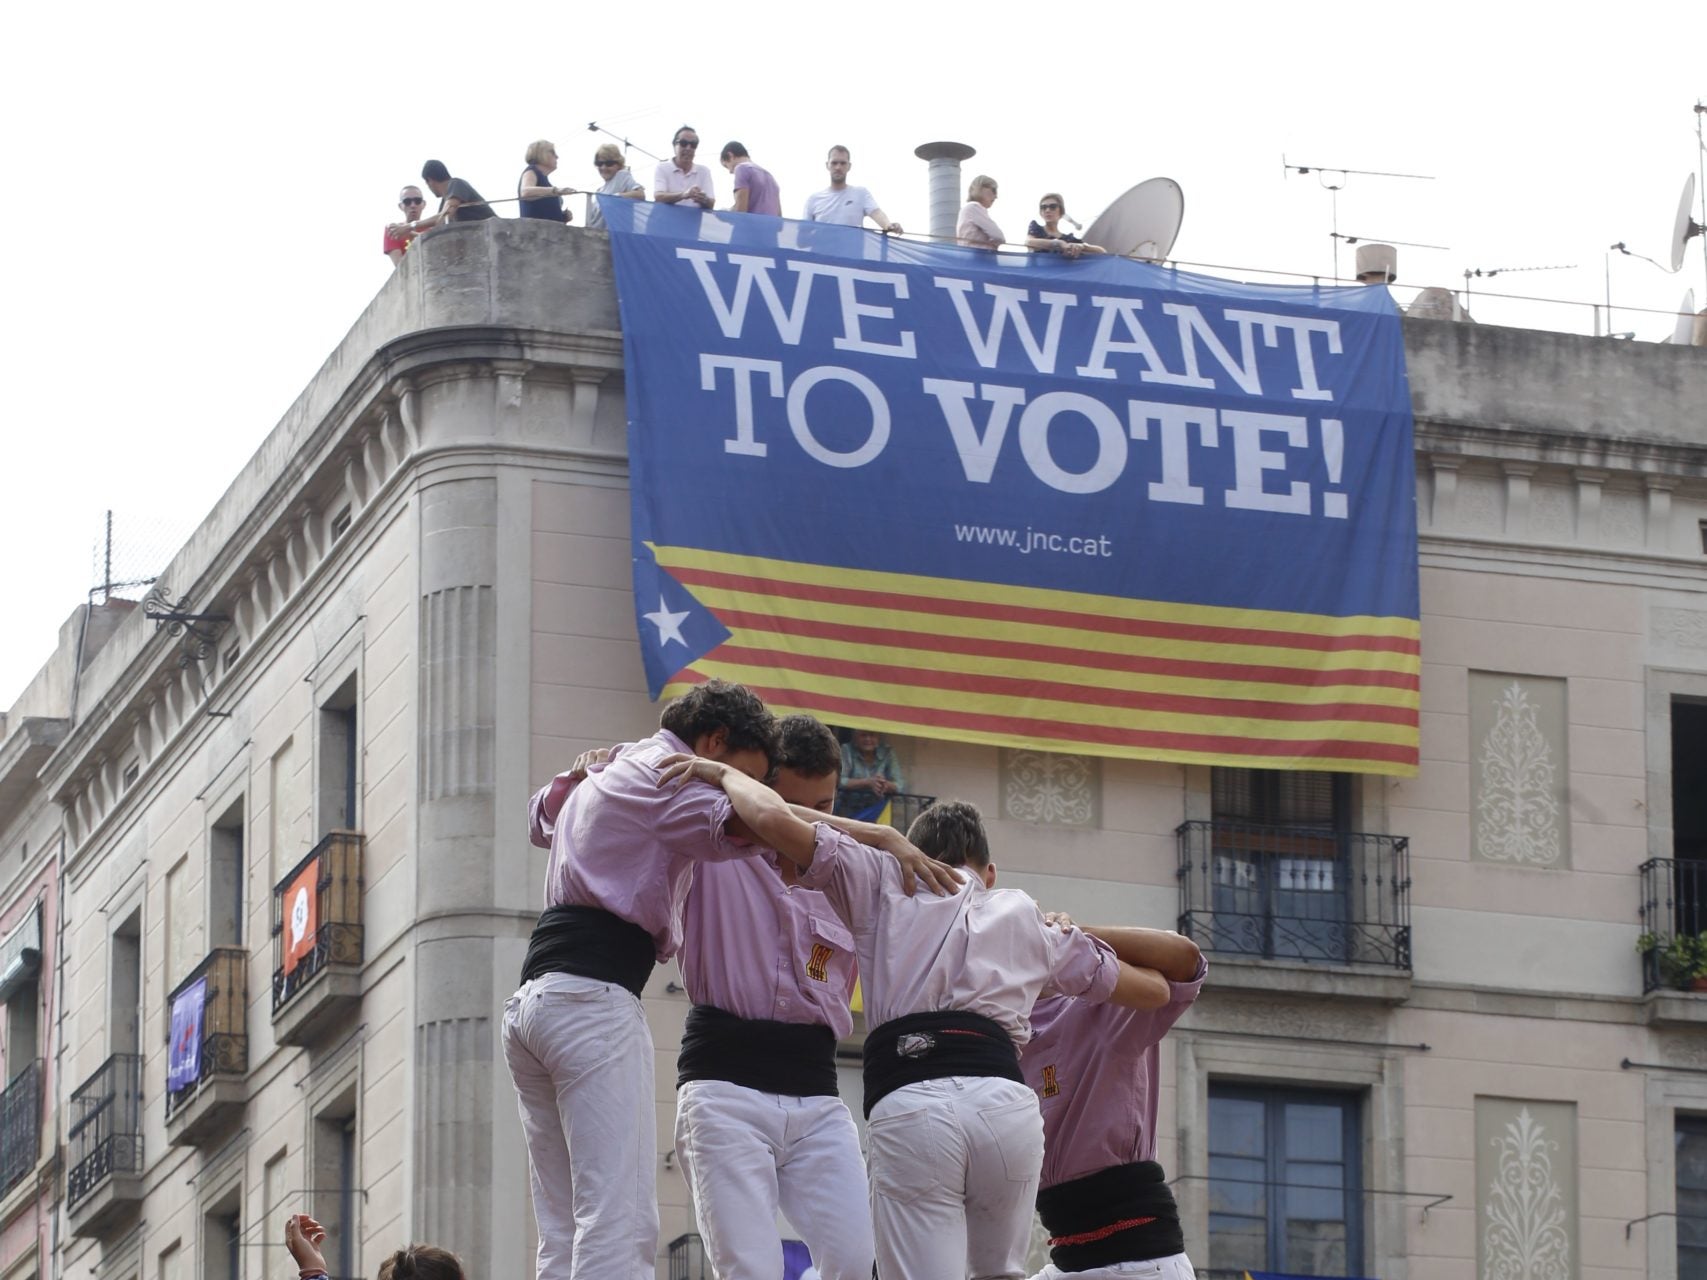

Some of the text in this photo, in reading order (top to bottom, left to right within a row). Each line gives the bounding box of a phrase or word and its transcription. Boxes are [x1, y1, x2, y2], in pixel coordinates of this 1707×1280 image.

[675, 246, 1344, 402] WE WANT
[698, 352, 1350, 520] TO VOTE!
[954, 523, 1113, 558] www.jnc.cat
